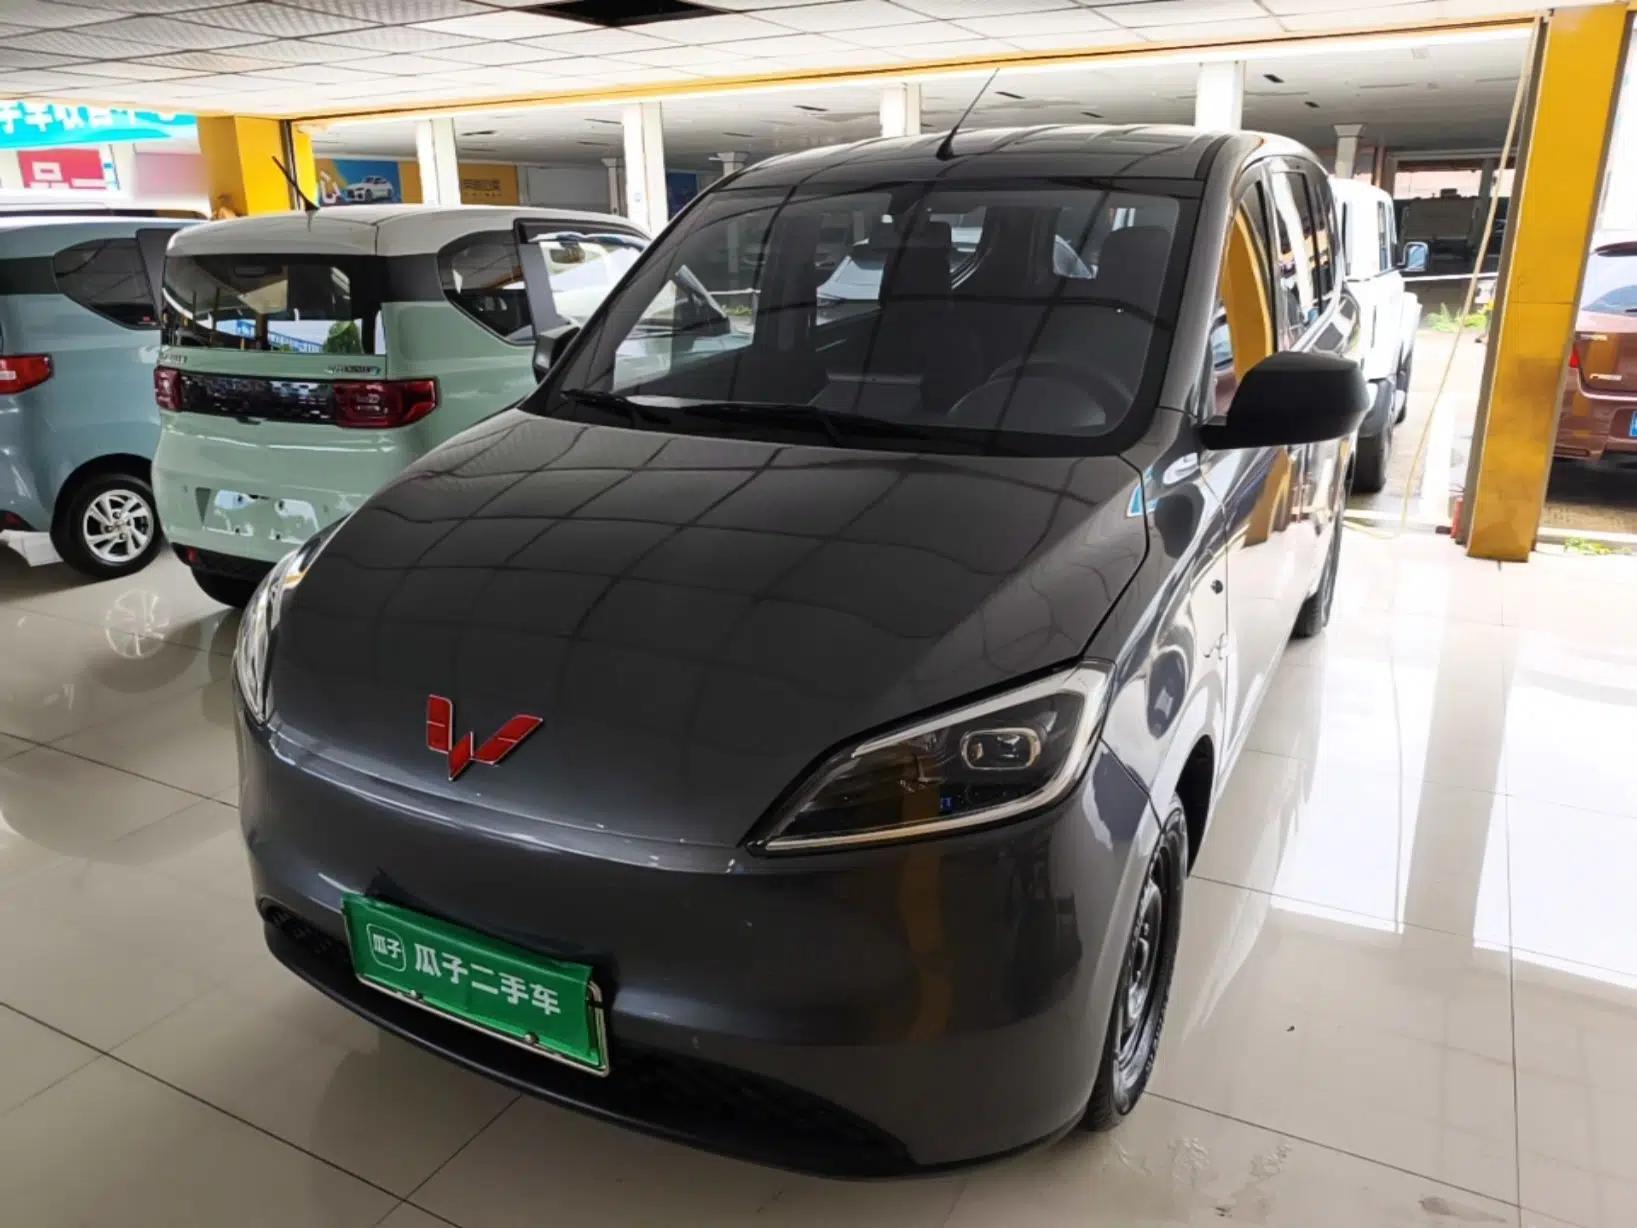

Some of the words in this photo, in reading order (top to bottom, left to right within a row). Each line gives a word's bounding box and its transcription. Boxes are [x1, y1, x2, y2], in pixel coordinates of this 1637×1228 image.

[373, 933, 401, 958] 瓜子
[414, 943, 561, 1015] 瓜子二手车
